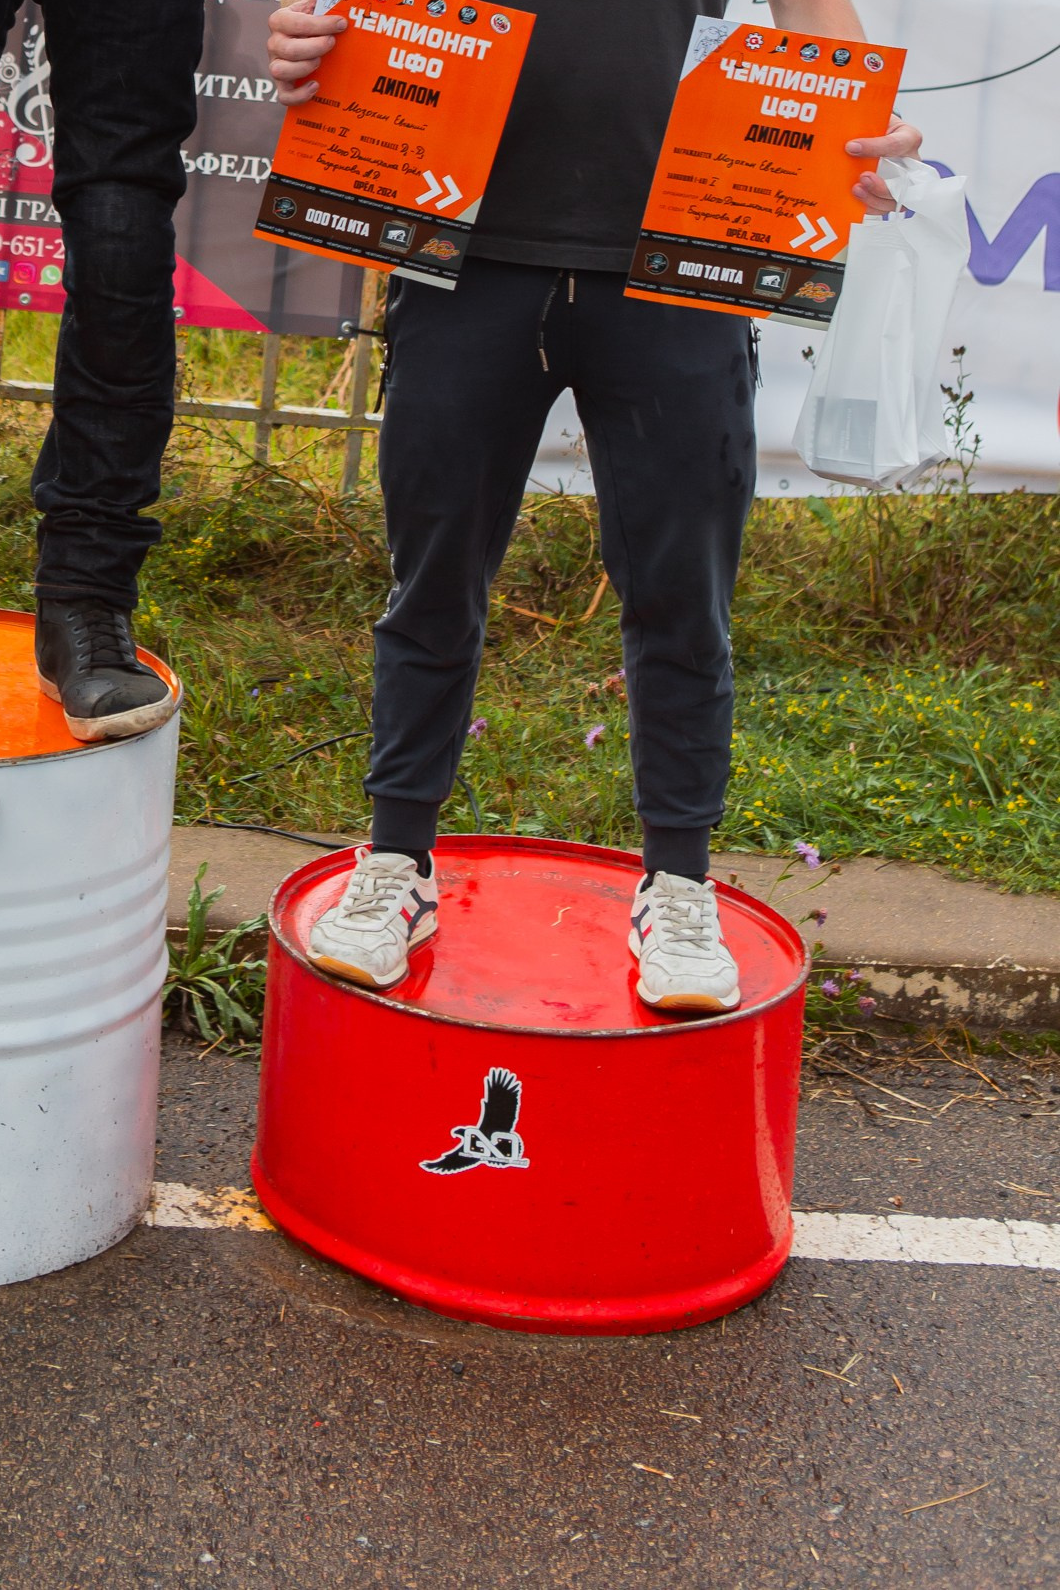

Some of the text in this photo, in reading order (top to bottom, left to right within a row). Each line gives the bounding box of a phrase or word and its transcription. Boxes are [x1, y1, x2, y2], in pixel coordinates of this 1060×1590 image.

[348, 7, 492, 60] ЧЕМПИОНАТ
[388, 47, 443, 78] ЦФО
[372, 76, 440, 107] ДИПЛОМ
[720, 58, 866, 100] ЧЕМПИОНАТ
[761, 96, 817, 122] ЦФО
[744, 124, 814, 151] ДИПЛОМ
[376, 186, 397, 198] 2024
[305, 208, 369, 237] ООО ТД ИТА
[750, 232, 771, 243] 2024
[678, 261, 743, 284] ООО ТД ИТА
